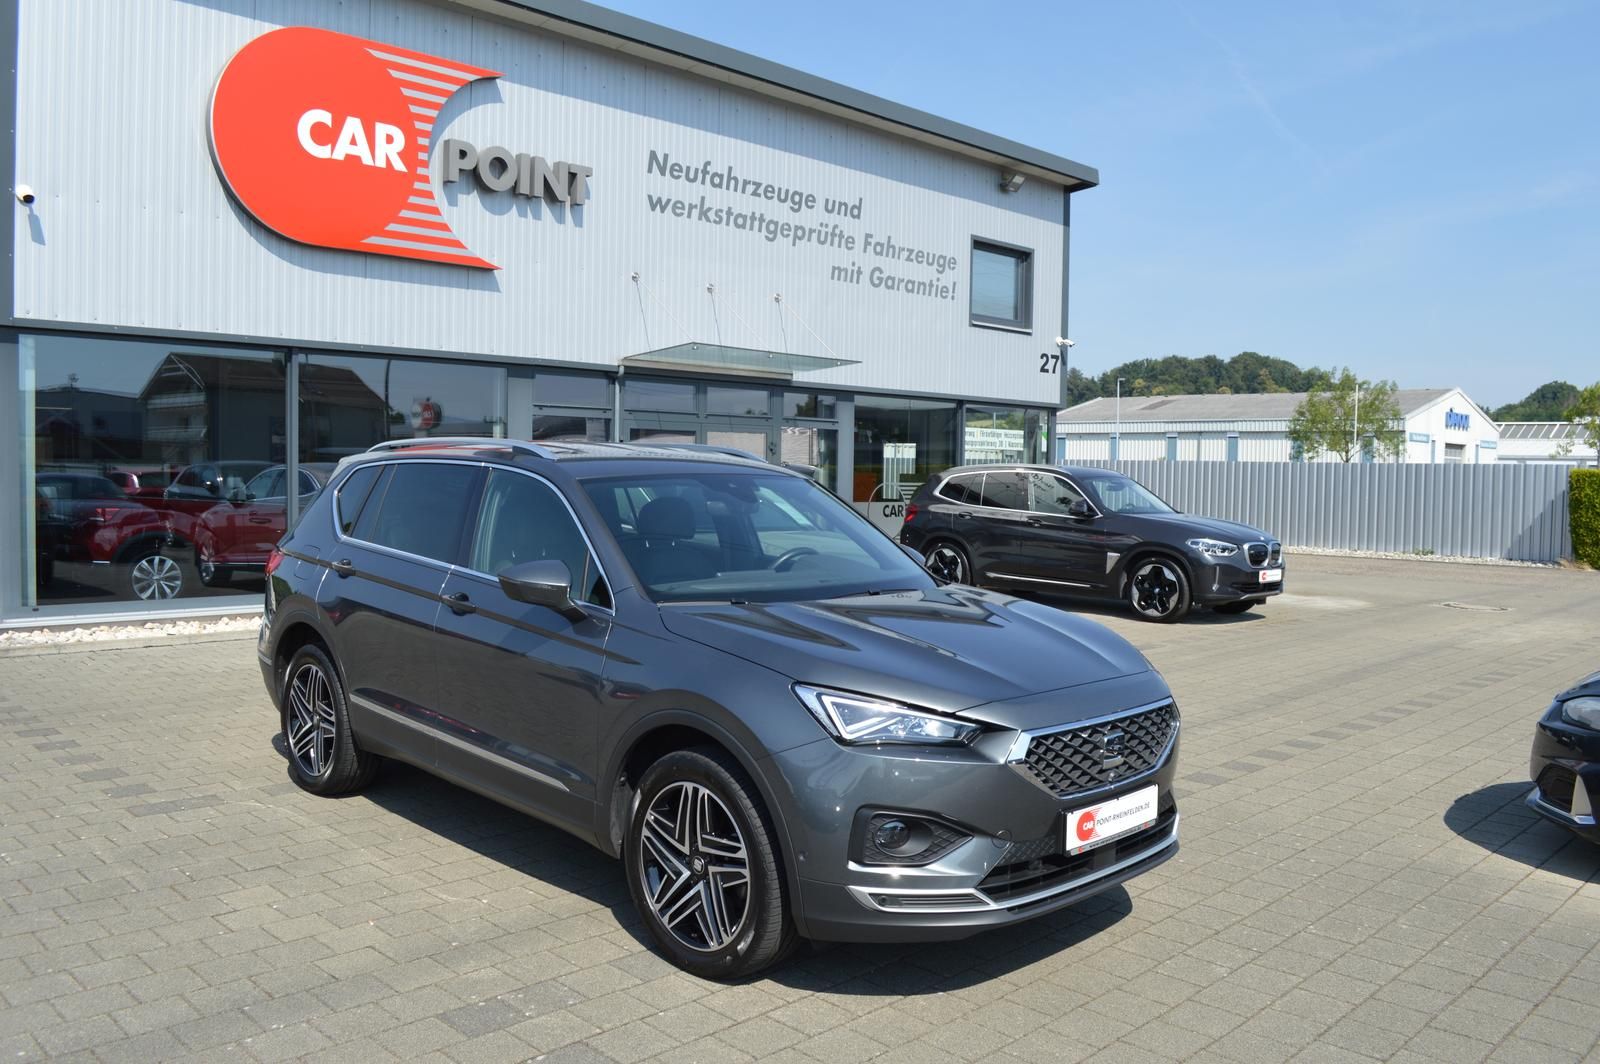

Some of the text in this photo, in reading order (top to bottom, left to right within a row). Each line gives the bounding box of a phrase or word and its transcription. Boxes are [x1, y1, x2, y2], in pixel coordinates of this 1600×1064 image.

[297, 109, 593, 206] CAR POINT
[647, 149, 863, 220] Neufahrzeuge und
[647, 194, 958, 274] werkstattgeprüfte Fahrzeuge
[830, 261, 957, 300] mit Garantie!
[1040, 353, 1060, 374] 27
[882, 504, 904, 518] CAR
[1083, 821, 1094, 830] CAR
